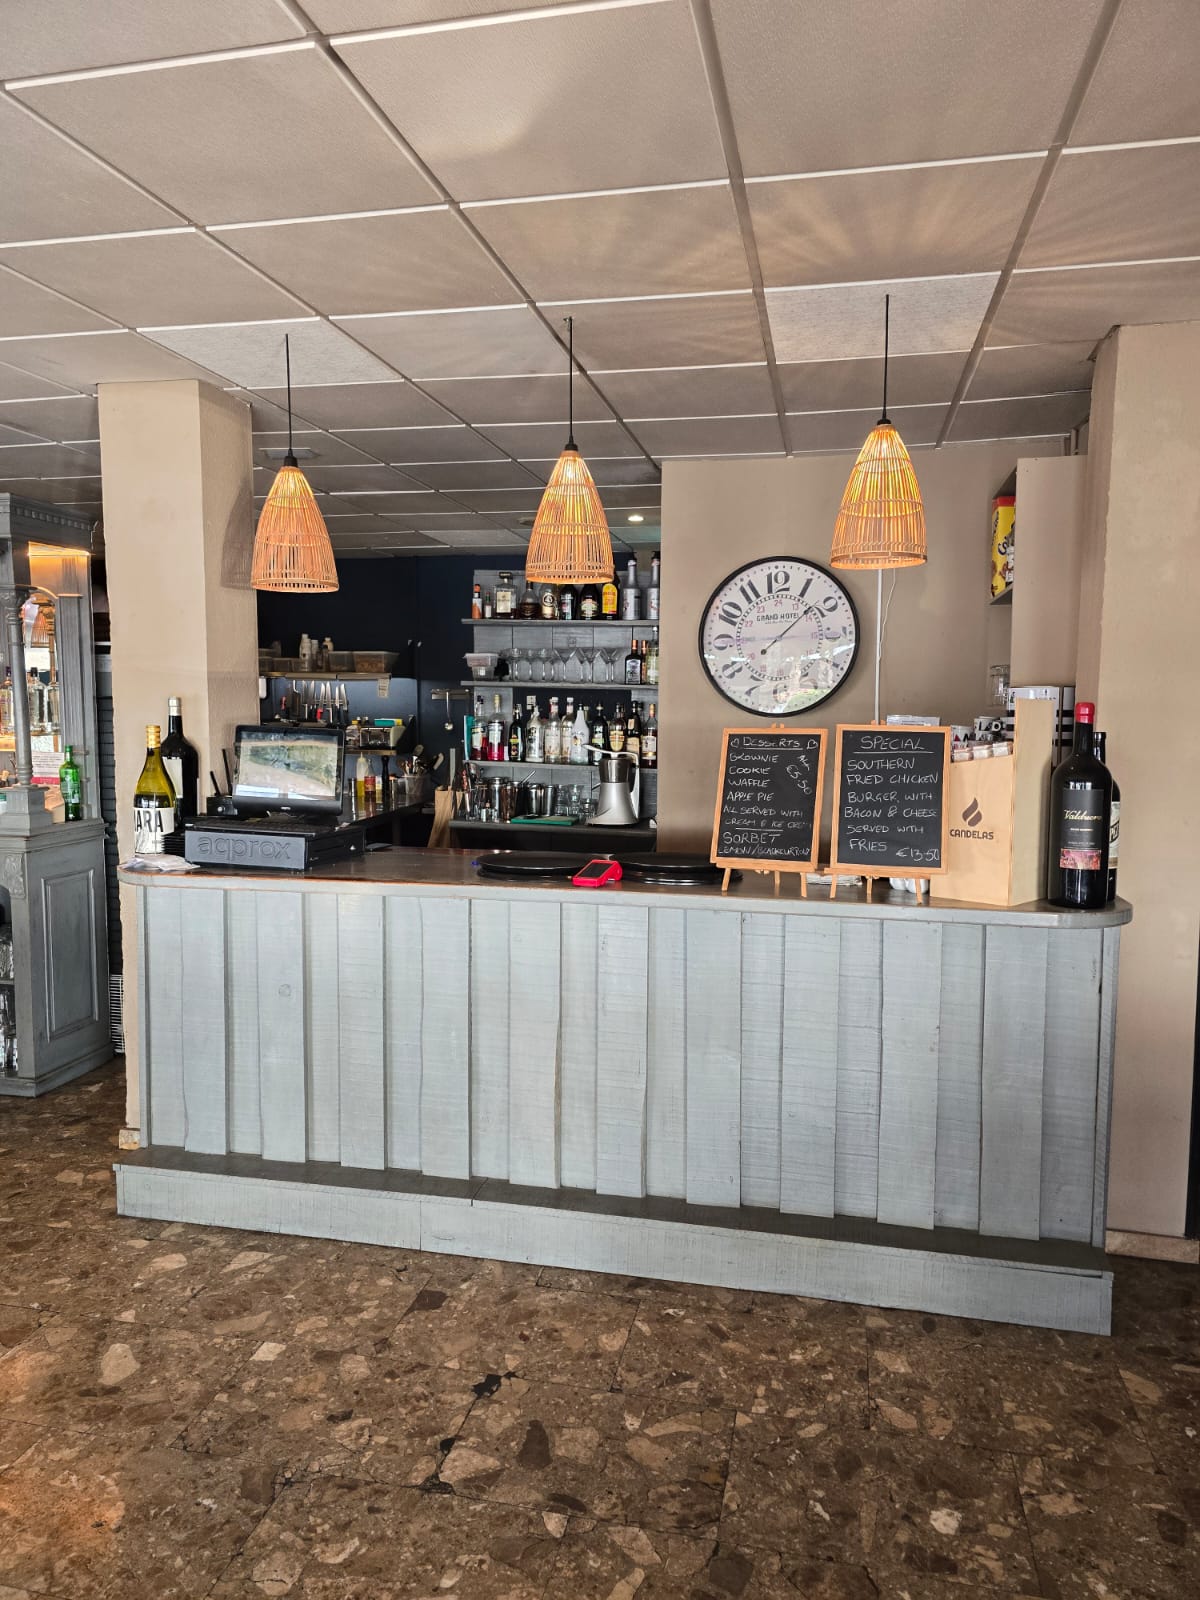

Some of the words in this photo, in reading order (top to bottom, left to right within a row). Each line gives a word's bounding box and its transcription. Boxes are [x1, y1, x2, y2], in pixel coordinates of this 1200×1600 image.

[766, 570, 791, 594] 12
[799, 578, 813, 598] 1
[739, 579, 761, 605] 11
[718, 601, 743, 627] 10
[756, 605, 765, 614] 23
[813, 596, 839, 618] 2
[756, 613, 778, 621] GRAND
[780, 612, 799, 620] HOTEL
[713, 633, 735, 651] 9
[722, 660, 743, 679] 8
[860, 735, 925, 750] SPECIAL
[729, 752, 779, 763] BROWNIE
[847, 757, 915, 771] SOUTHERN
[729, 765, 771, 775] COOKIE
[727, 778, 771, 788] WAFFLE
[889, 771, 938, 784] CHICKEN
[726, 790, 754, 802] APPLE
[757, 792, 775, 802] PIE
[904, 792, 934, 801] WITH
[740, 805, 776, 816] SERVED
[780, 809, 803, 818] WITH
[844, 806, 882, 819] BACON
[887, 805, 898, 818] &
[134, 809, 164, 833] ARA
[846, 824, 889, 835] SERVED
[896, 825, 924, 834] WITH
[949, 828, 994, 841] CANDELAS
[722, 831, 781, 846] SORBET
[848, 838, 888, 852] FRIES
